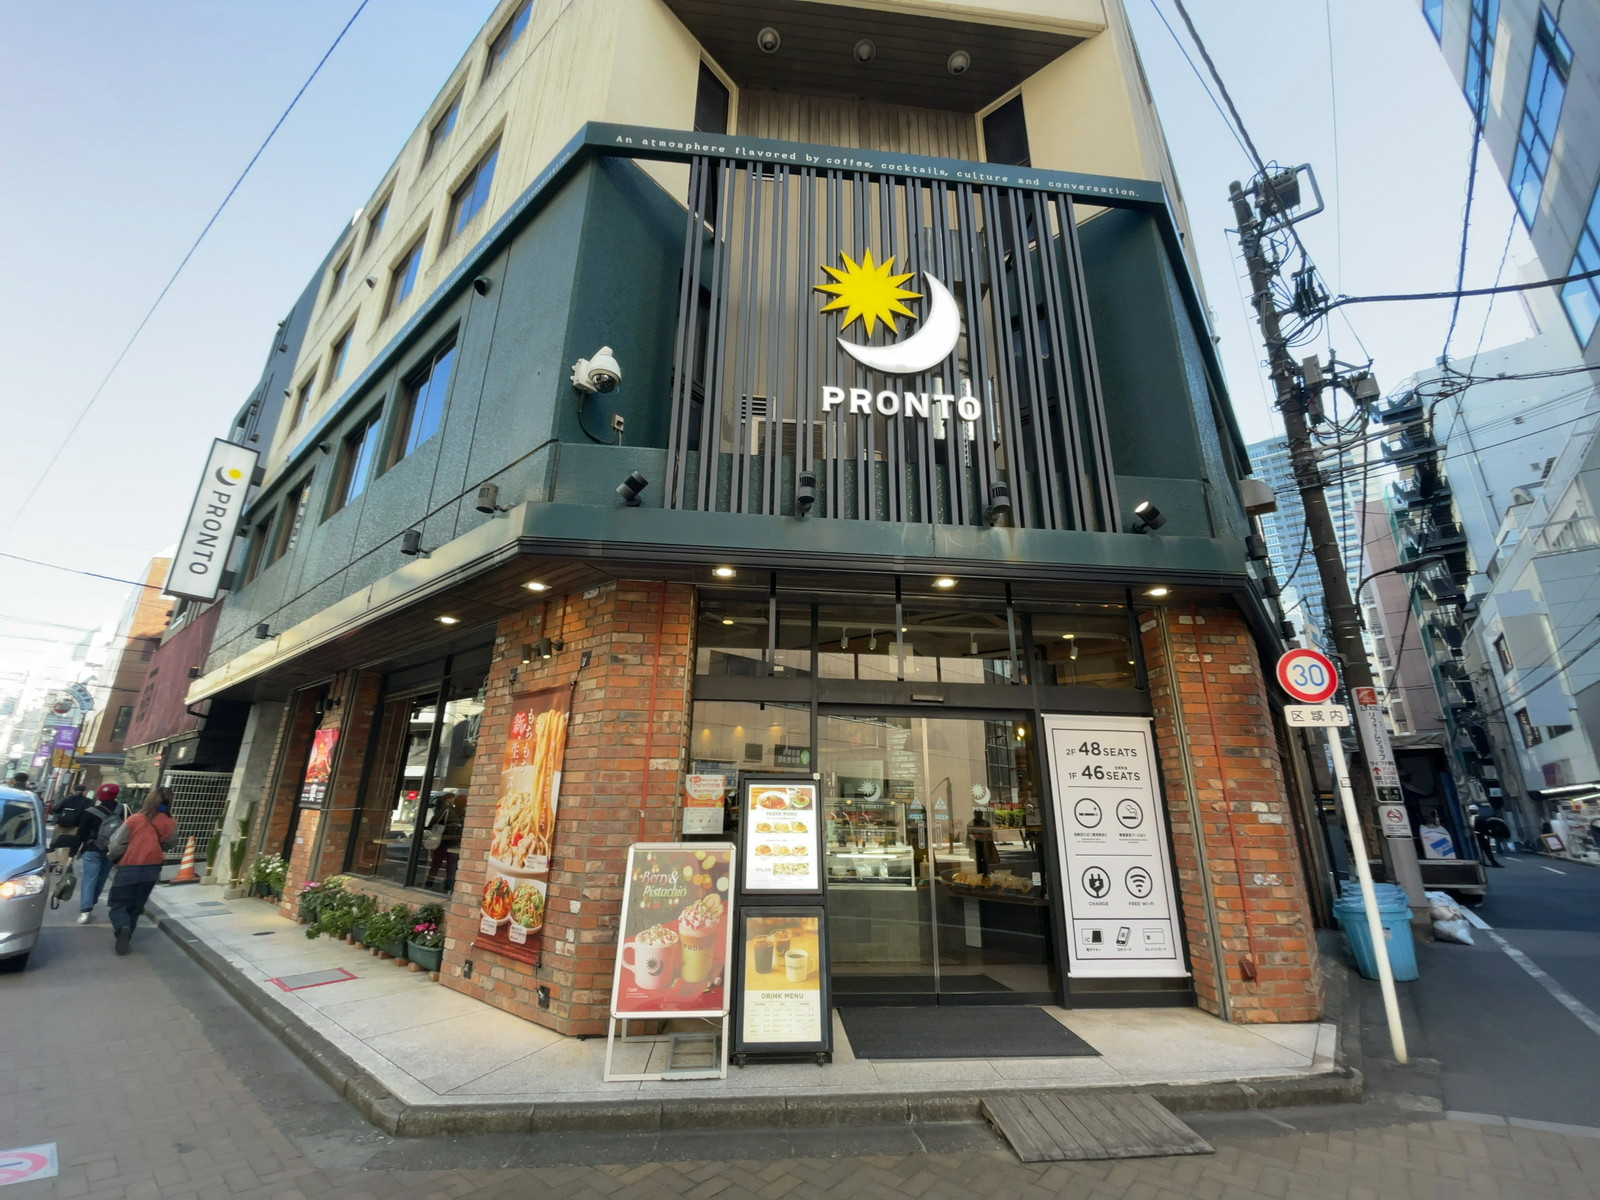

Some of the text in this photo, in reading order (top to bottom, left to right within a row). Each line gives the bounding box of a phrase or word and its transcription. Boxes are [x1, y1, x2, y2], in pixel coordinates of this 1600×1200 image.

[616, 135, 633, 144] An
[642, 138, 725, 153] atmosphere
[735, 146, 796, 160] flavored
[806, 153, 820, 163] by
[957, 170, 1008, 183] culture
[1017, 177, 1040, 186] and
[1048, 180, 1140, 197] conversation.
[822, 386, 981, 421] PRONTO
[189, 490, 231, 575] PRONTO
[1292, 664, 1325, 687] 30
[1291, 710, 1343, 722] 区域内
[506, 712, 527, 805] 新・生パス
[1078, 742, 1101, 756] 48
[1103, 748, 1137, 757] SEATS
[1082, 765, 1105, 780] 46
[1107, 771, 1141, 781] SEATS
[642, 885, 687, 898] Pistachio
